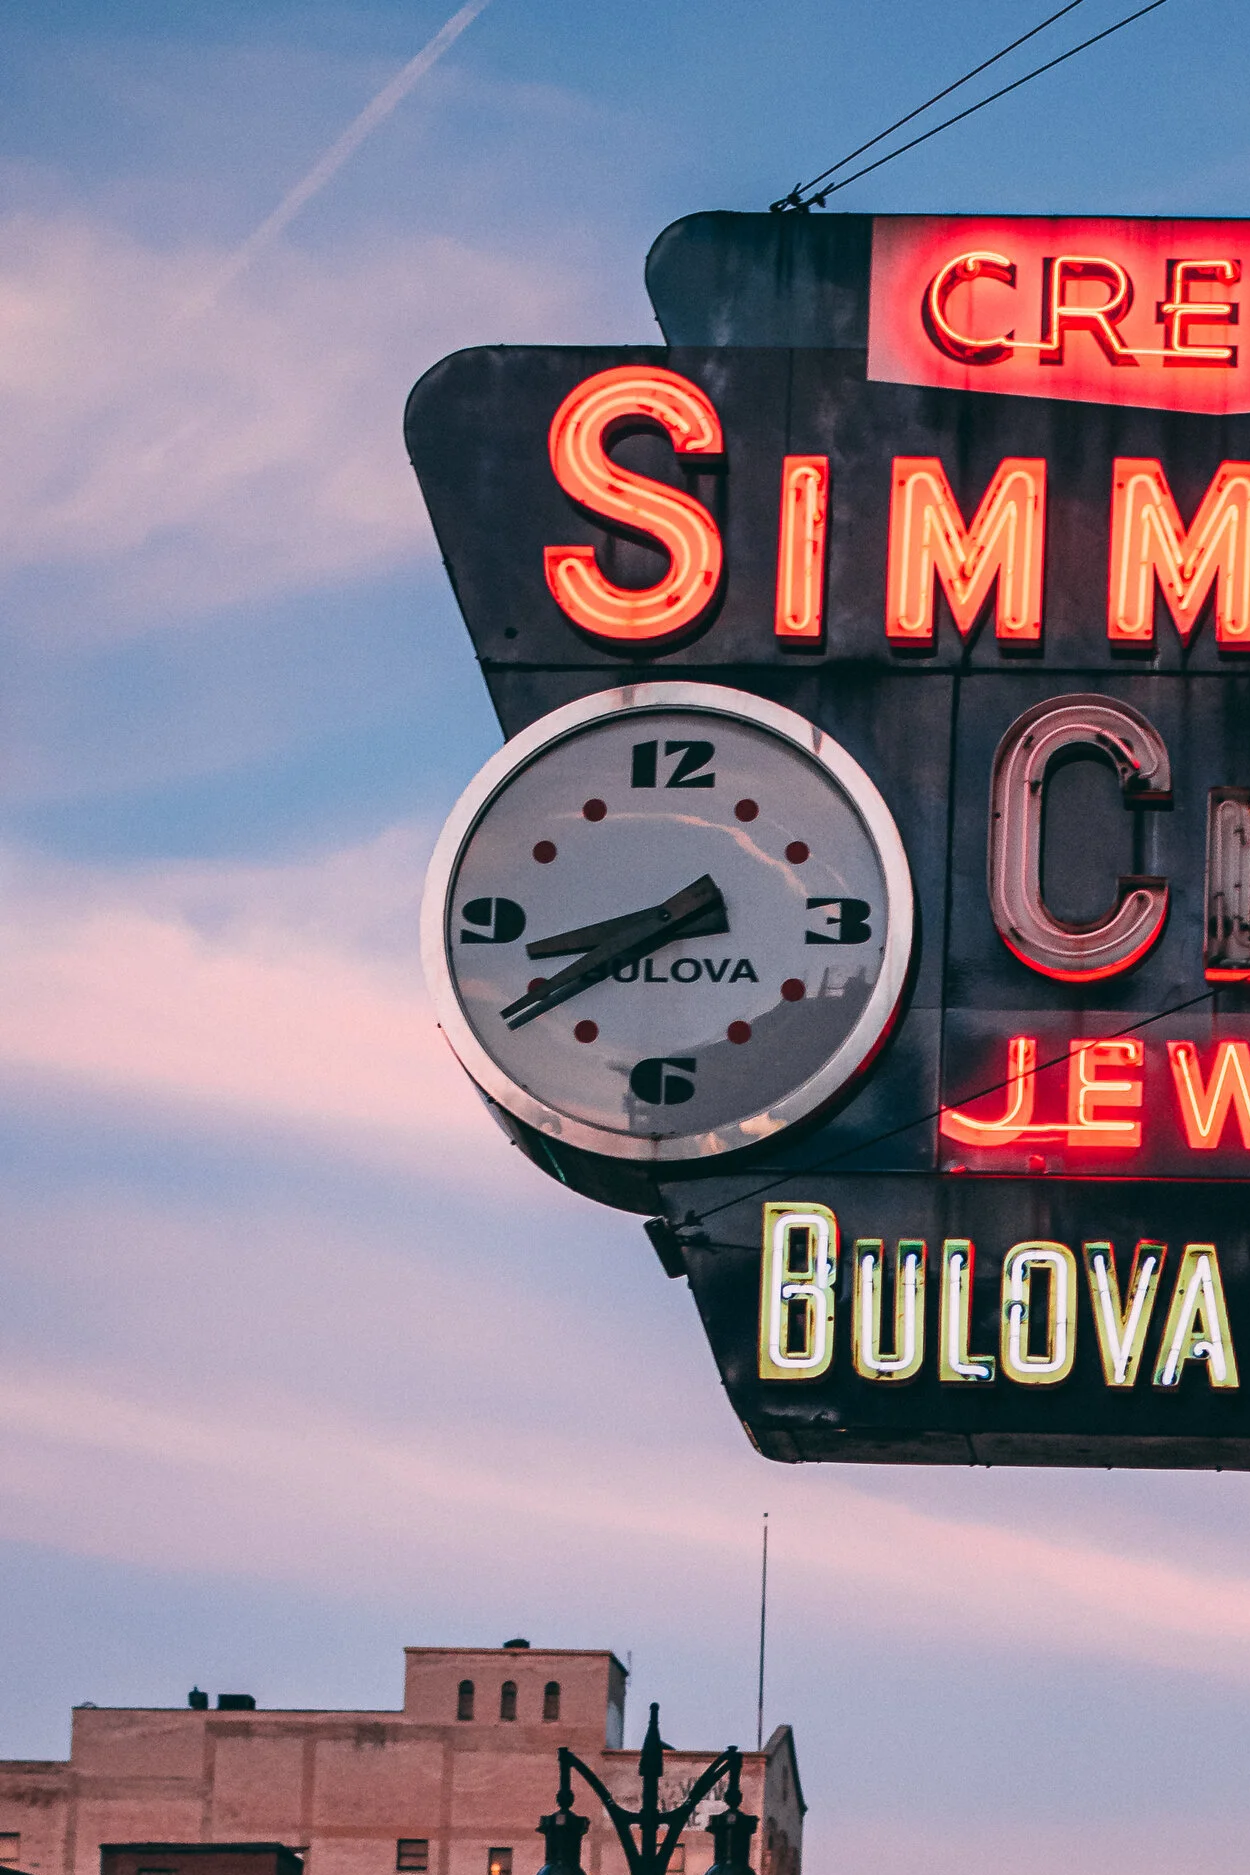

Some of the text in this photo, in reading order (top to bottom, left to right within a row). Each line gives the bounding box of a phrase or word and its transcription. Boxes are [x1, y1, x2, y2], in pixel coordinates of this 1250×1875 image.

[629, 740, 716, 790] 12
[804, 896, 873, 945] 3
[590, 957, 760, 984] ULOVA
[629, 1056, 698, 1106] 6
[758, 1201, 1241, 1388] BULOVA
